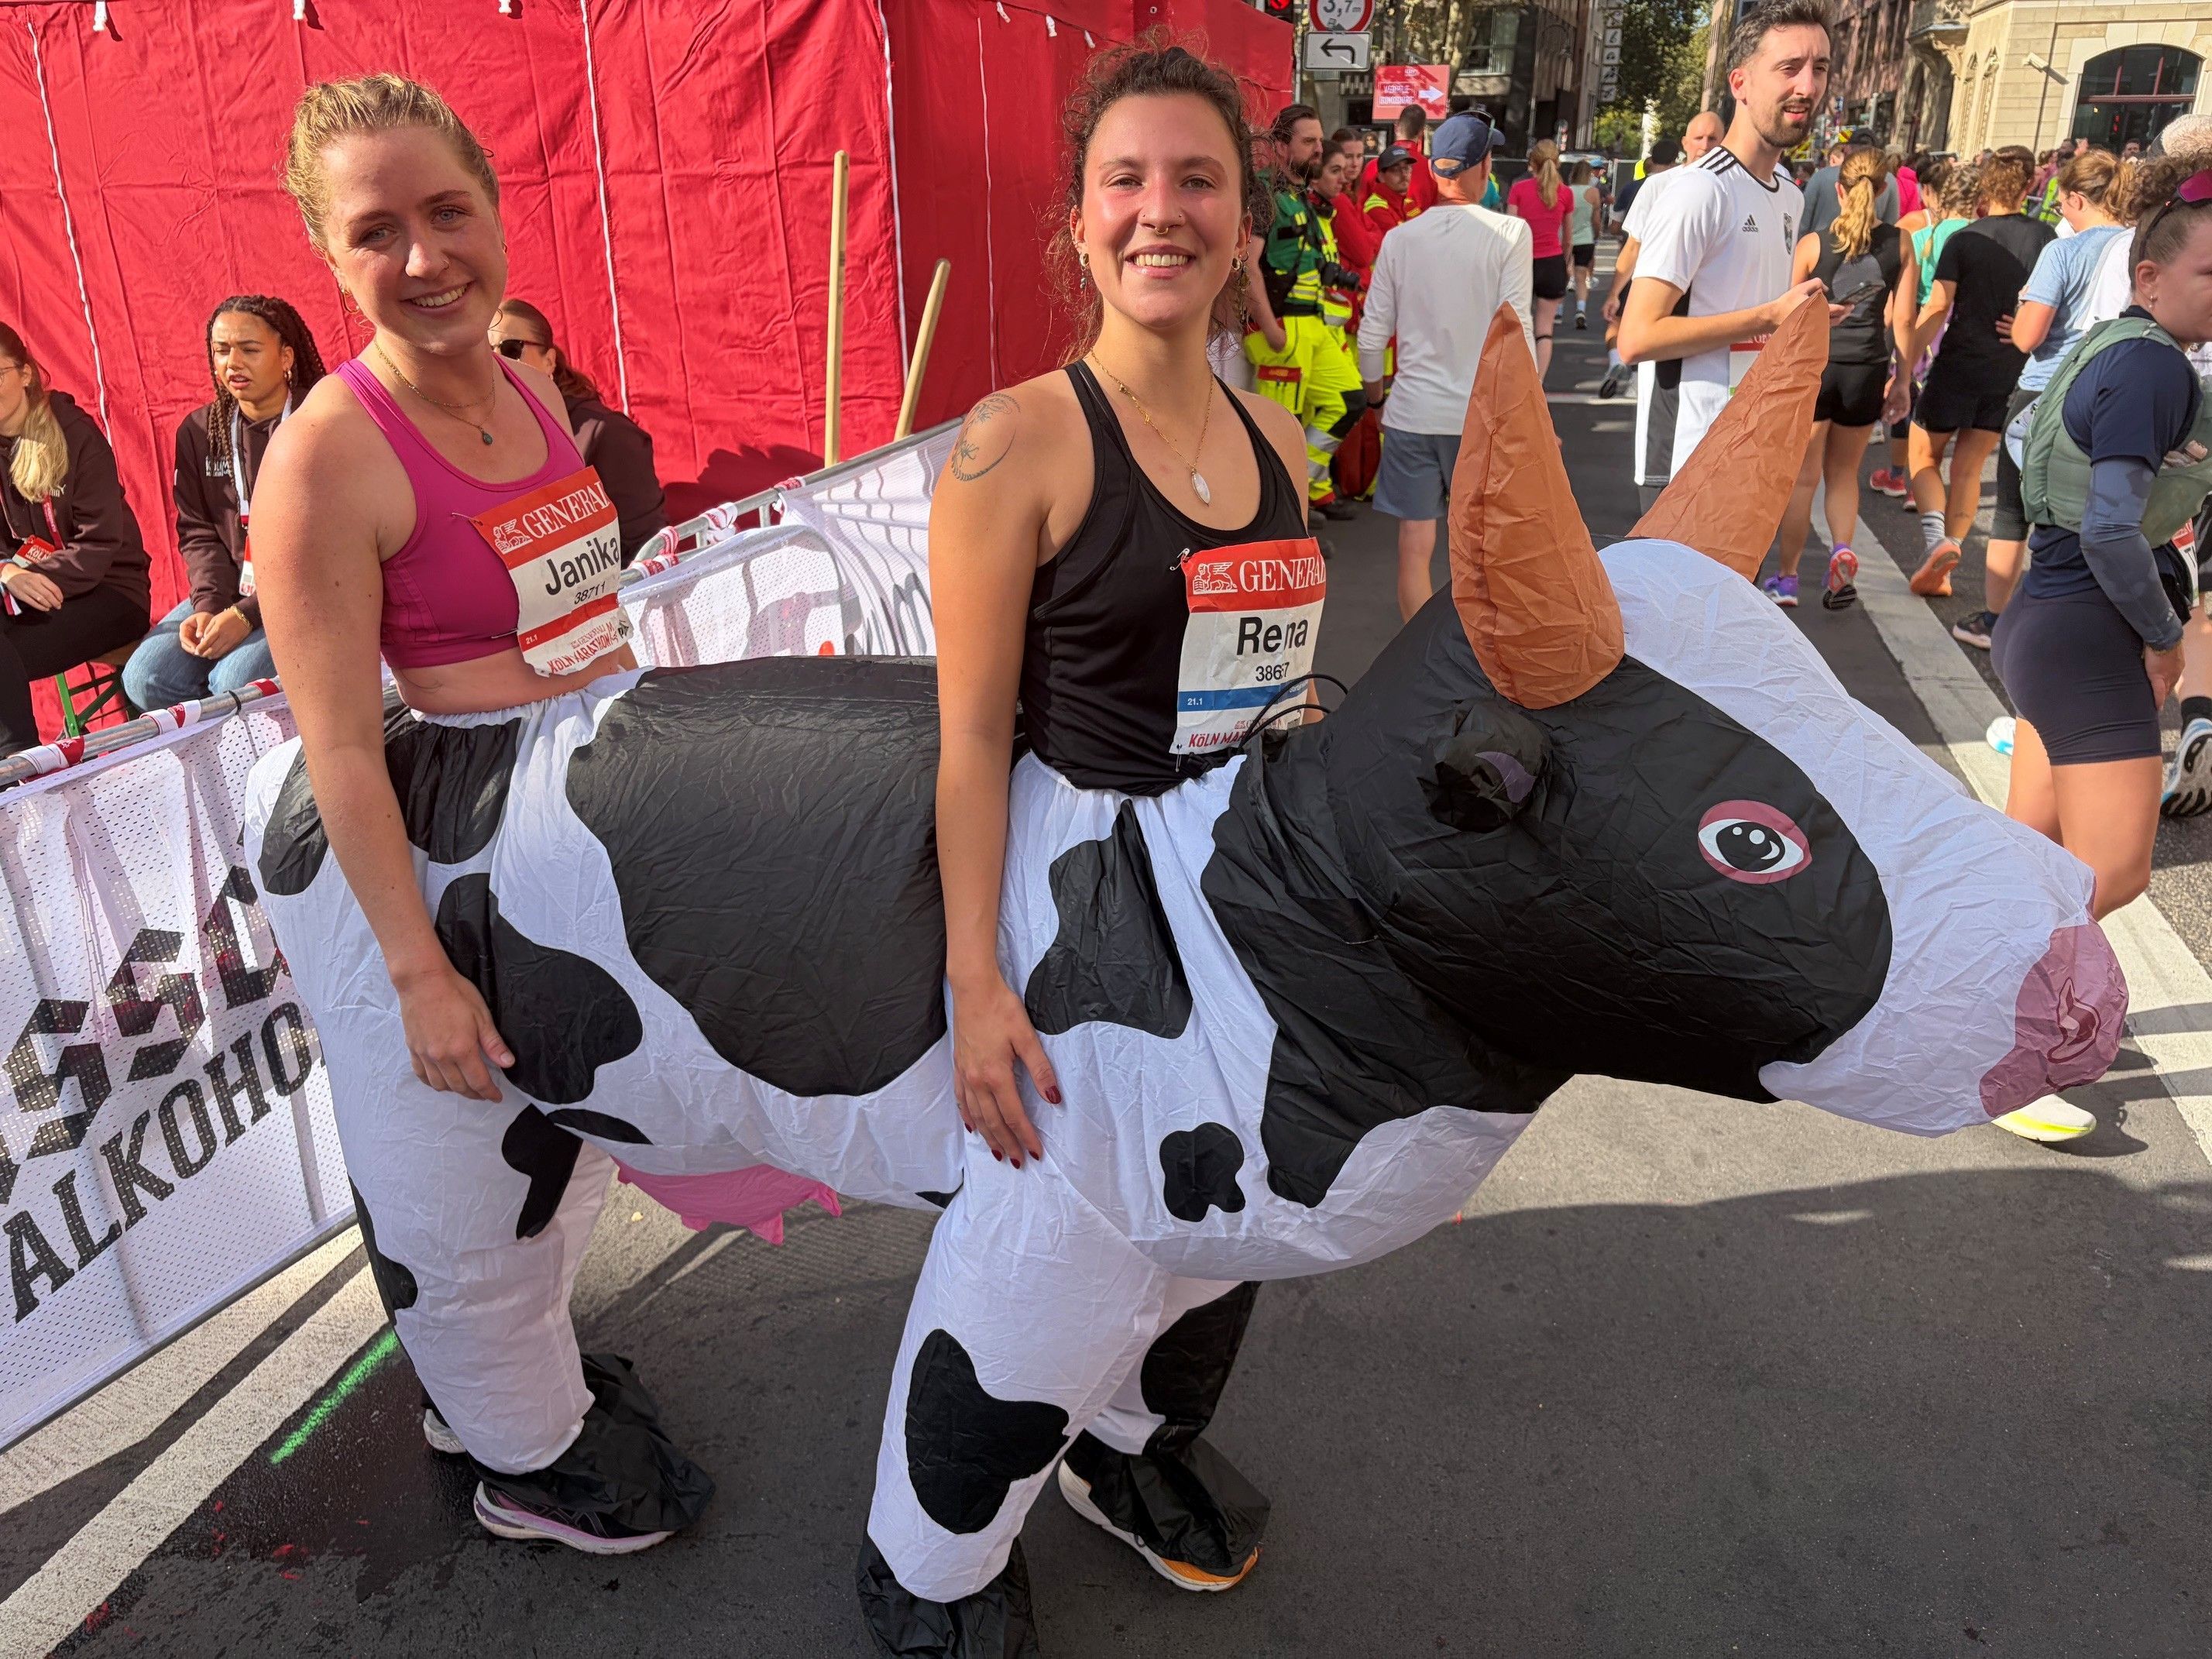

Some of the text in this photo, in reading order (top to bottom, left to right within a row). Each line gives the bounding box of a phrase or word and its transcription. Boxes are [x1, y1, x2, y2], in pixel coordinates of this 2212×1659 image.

[522, 481, 611, 539] GENERAL
[545, 537, 620, 596] Janika
[1240, 556, 1326, 592] GENERAL
[574, 581, 606, 605] 38711
[525, 634, 538, 645] 21.1
[1237, 617, 1309, 656] Rena
[1188, 733, 1221, 748] KÖLN
[3, 1001, 327, 1324] ALKOHO
